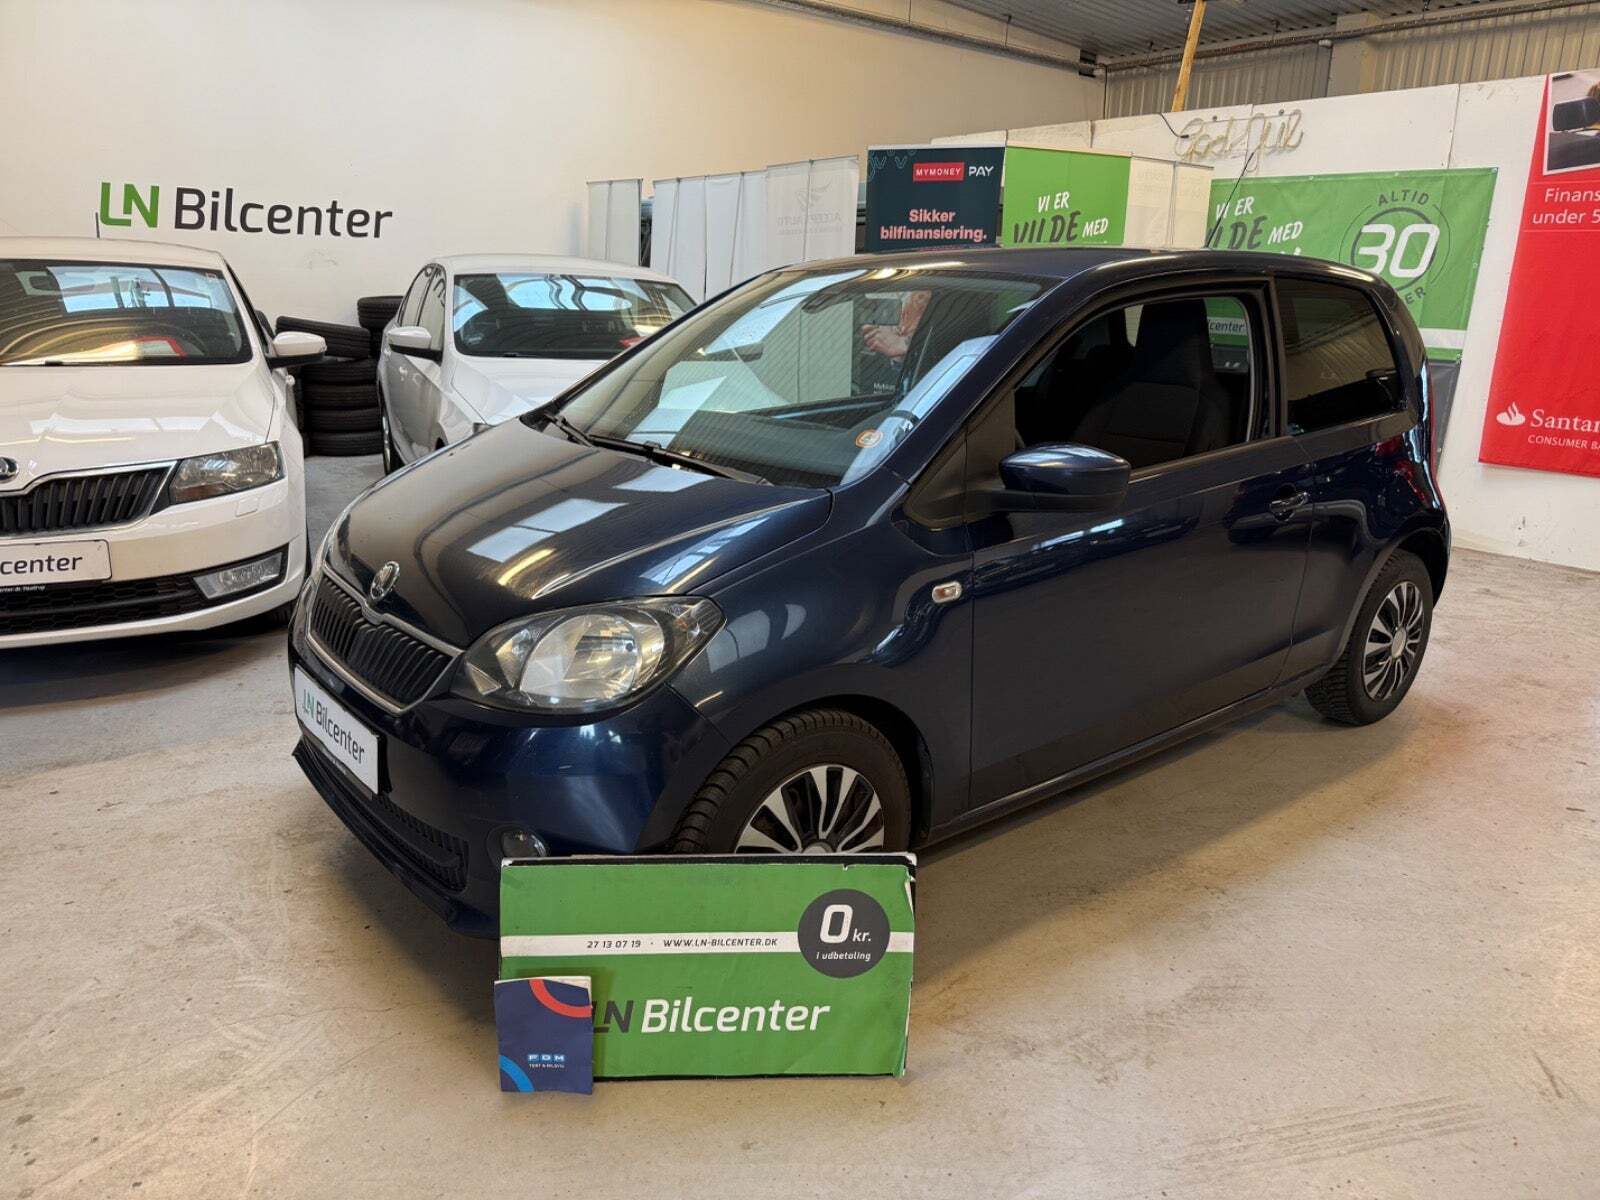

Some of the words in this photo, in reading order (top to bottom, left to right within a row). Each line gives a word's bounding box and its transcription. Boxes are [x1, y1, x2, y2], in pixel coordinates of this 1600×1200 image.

[915, 167, 962, 177] MYMONEY
[968, 166, 994, 177] PAY
[1038, 195, 1050, 213] VI
[1053, 191, 1070, 209] ER
[1215, 202, 1230, 220] VI
[1234, 196, 1255, 216] ER
[1378, 189, 1429, 206] ALTID
[100, 182, 160, 228] LN
[174, 186, 393, 238] Bilcenter
[908, 208, 956, 223] Sikker
[1532, 209, 1587, 224] under
[880, 225, 987, 243] bilfinansiering.
[1082, 217, 1109, 238] MED
[1267, 221, 1303, 245] MED
[1359, 224, 1440, 278] 30
[1527, 434, 1588, 448] CONSUMER
[303, 688, 315, 719] LN
[316, 700, 365, 764] Bilcenter
[820, 904, 853, 943] 0
[852, 928, 872, 942] kr.
[602, 940, 613, 948] 13
[615, 940, 628, 948] 07
[632, 940, 642, 948] 19
[663, 938, 779, 948] WWW.LN-BILCENTER.DK
[822, 951, 872, 962] udbetaling
[641, 996, 831, 1033] Bilcenter
